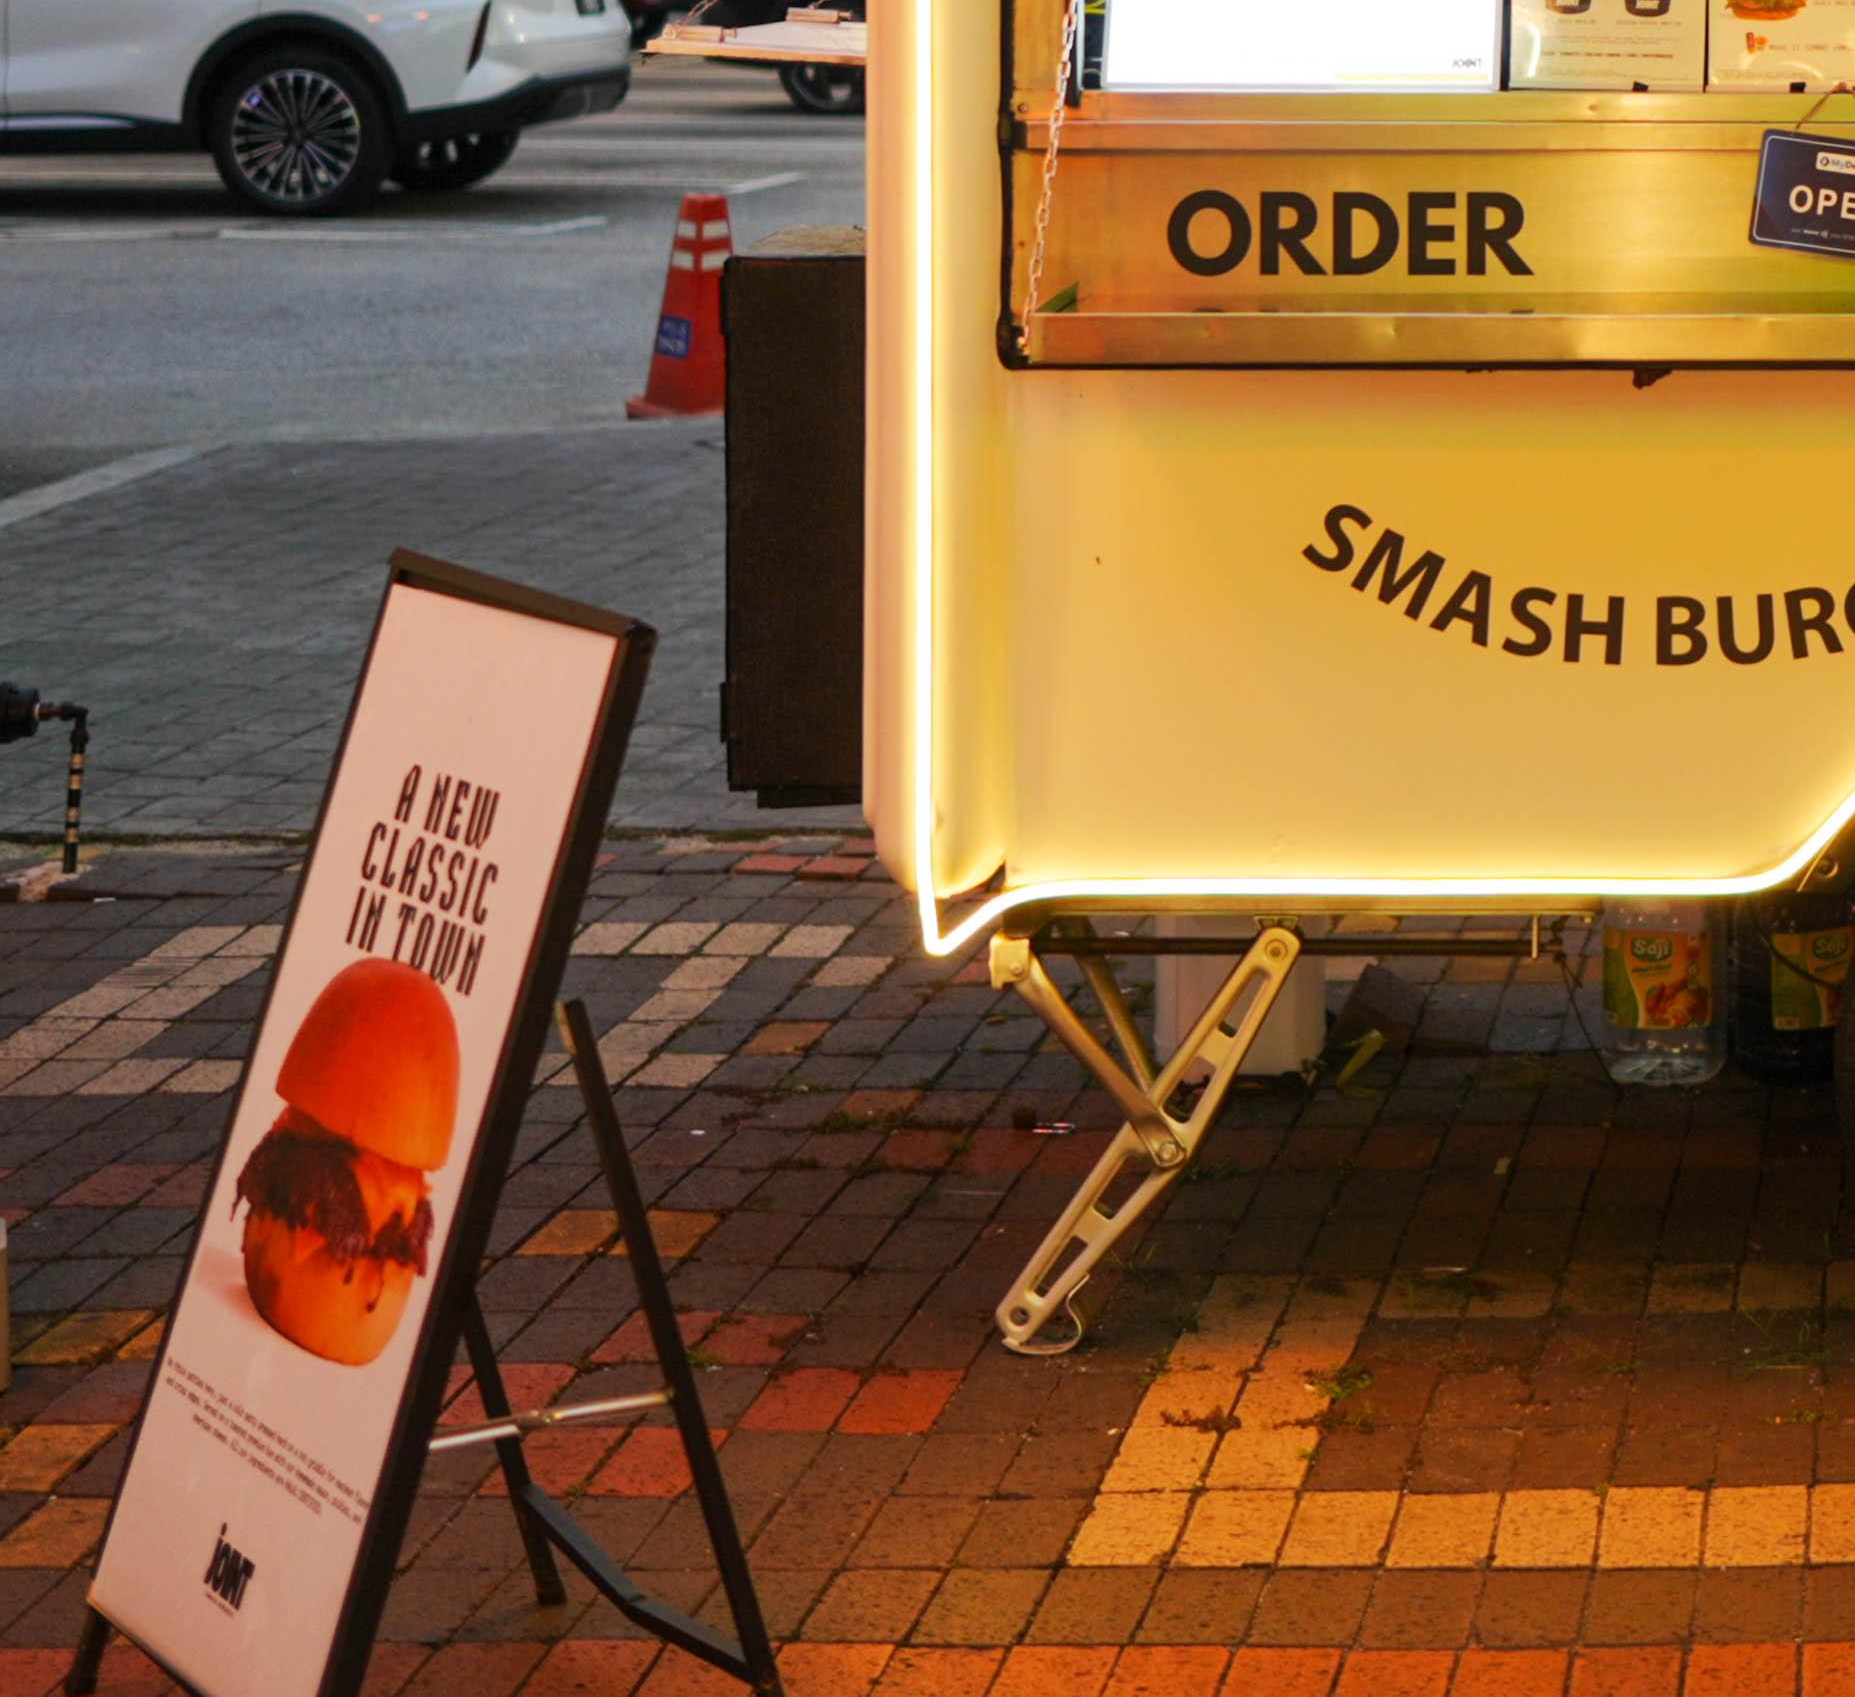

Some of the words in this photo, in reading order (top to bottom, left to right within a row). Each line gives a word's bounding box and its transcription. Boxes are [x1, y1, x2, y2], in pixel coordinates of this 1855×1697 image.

[1166, 189, 1535, 277] ORDER
[1301, 503, 1626, 666] SMASH
[394, 764, 422, 824] A
[423, 773, 501, 850] NEW
[361, 821, 499, 926] CLASSIC
[345, 886, 387, 954] IN
[391, 901, 486, 996] TOWN
[1633, 938, 1669, 959] Saji
